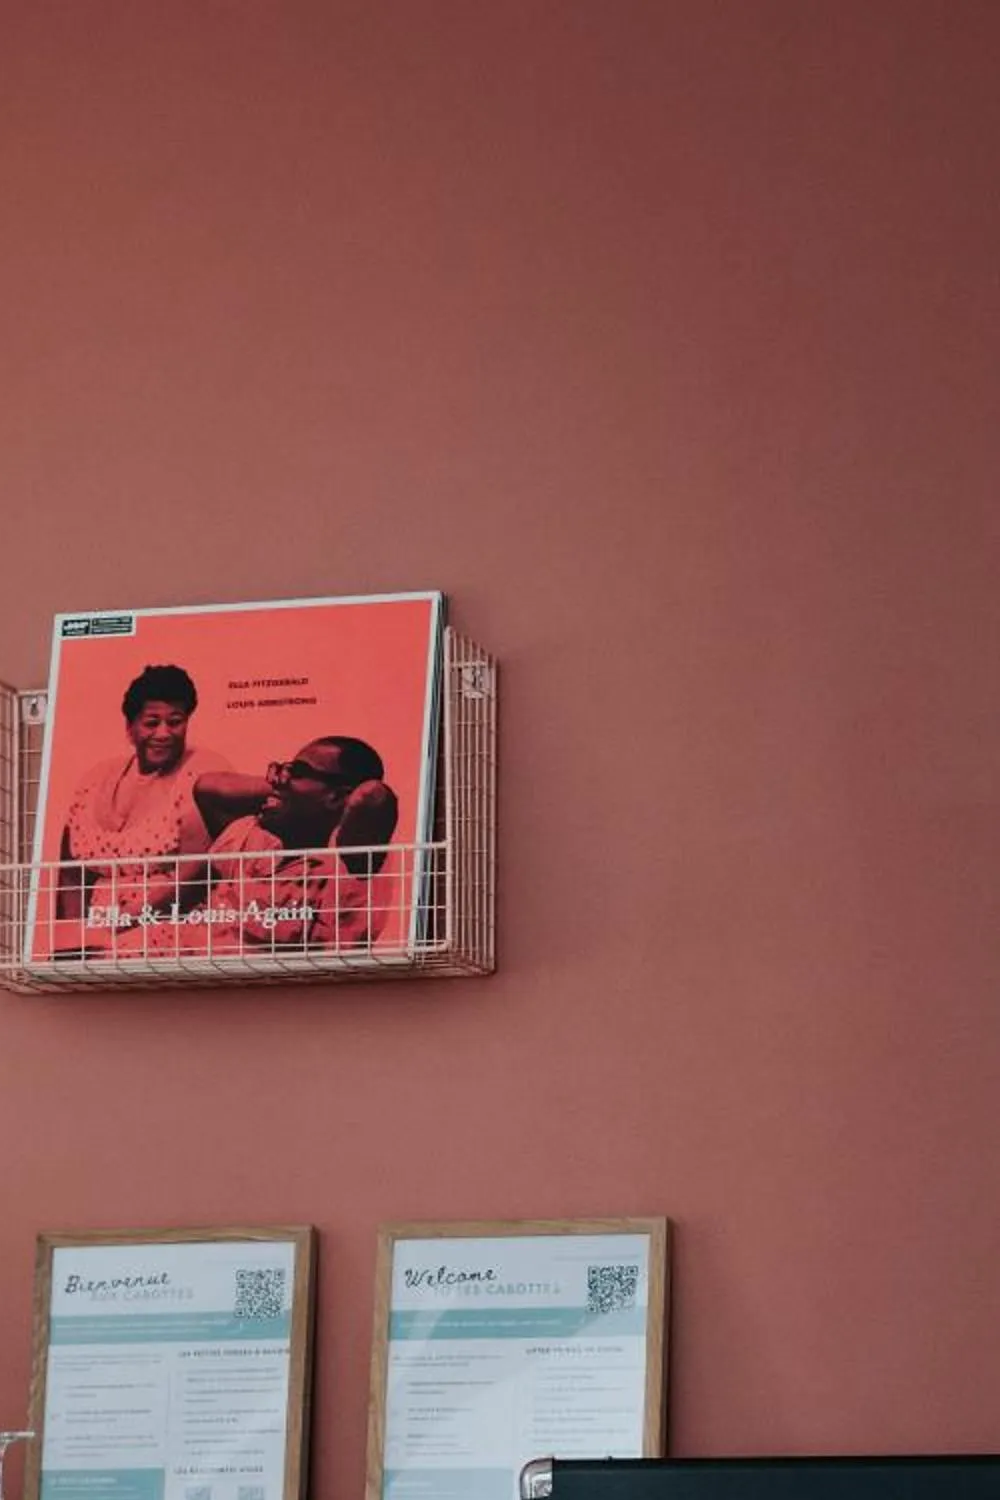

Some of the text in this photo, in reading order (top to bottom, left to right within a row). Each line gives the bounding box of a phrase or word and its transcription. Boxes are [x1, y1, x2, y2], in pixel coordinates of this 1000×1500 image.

[87, 899, 314, 929] Ella & Louis Again
[64, 1271, 171, 1295] Bienvenue
[404, 1264, 498, 1288] Welcome
